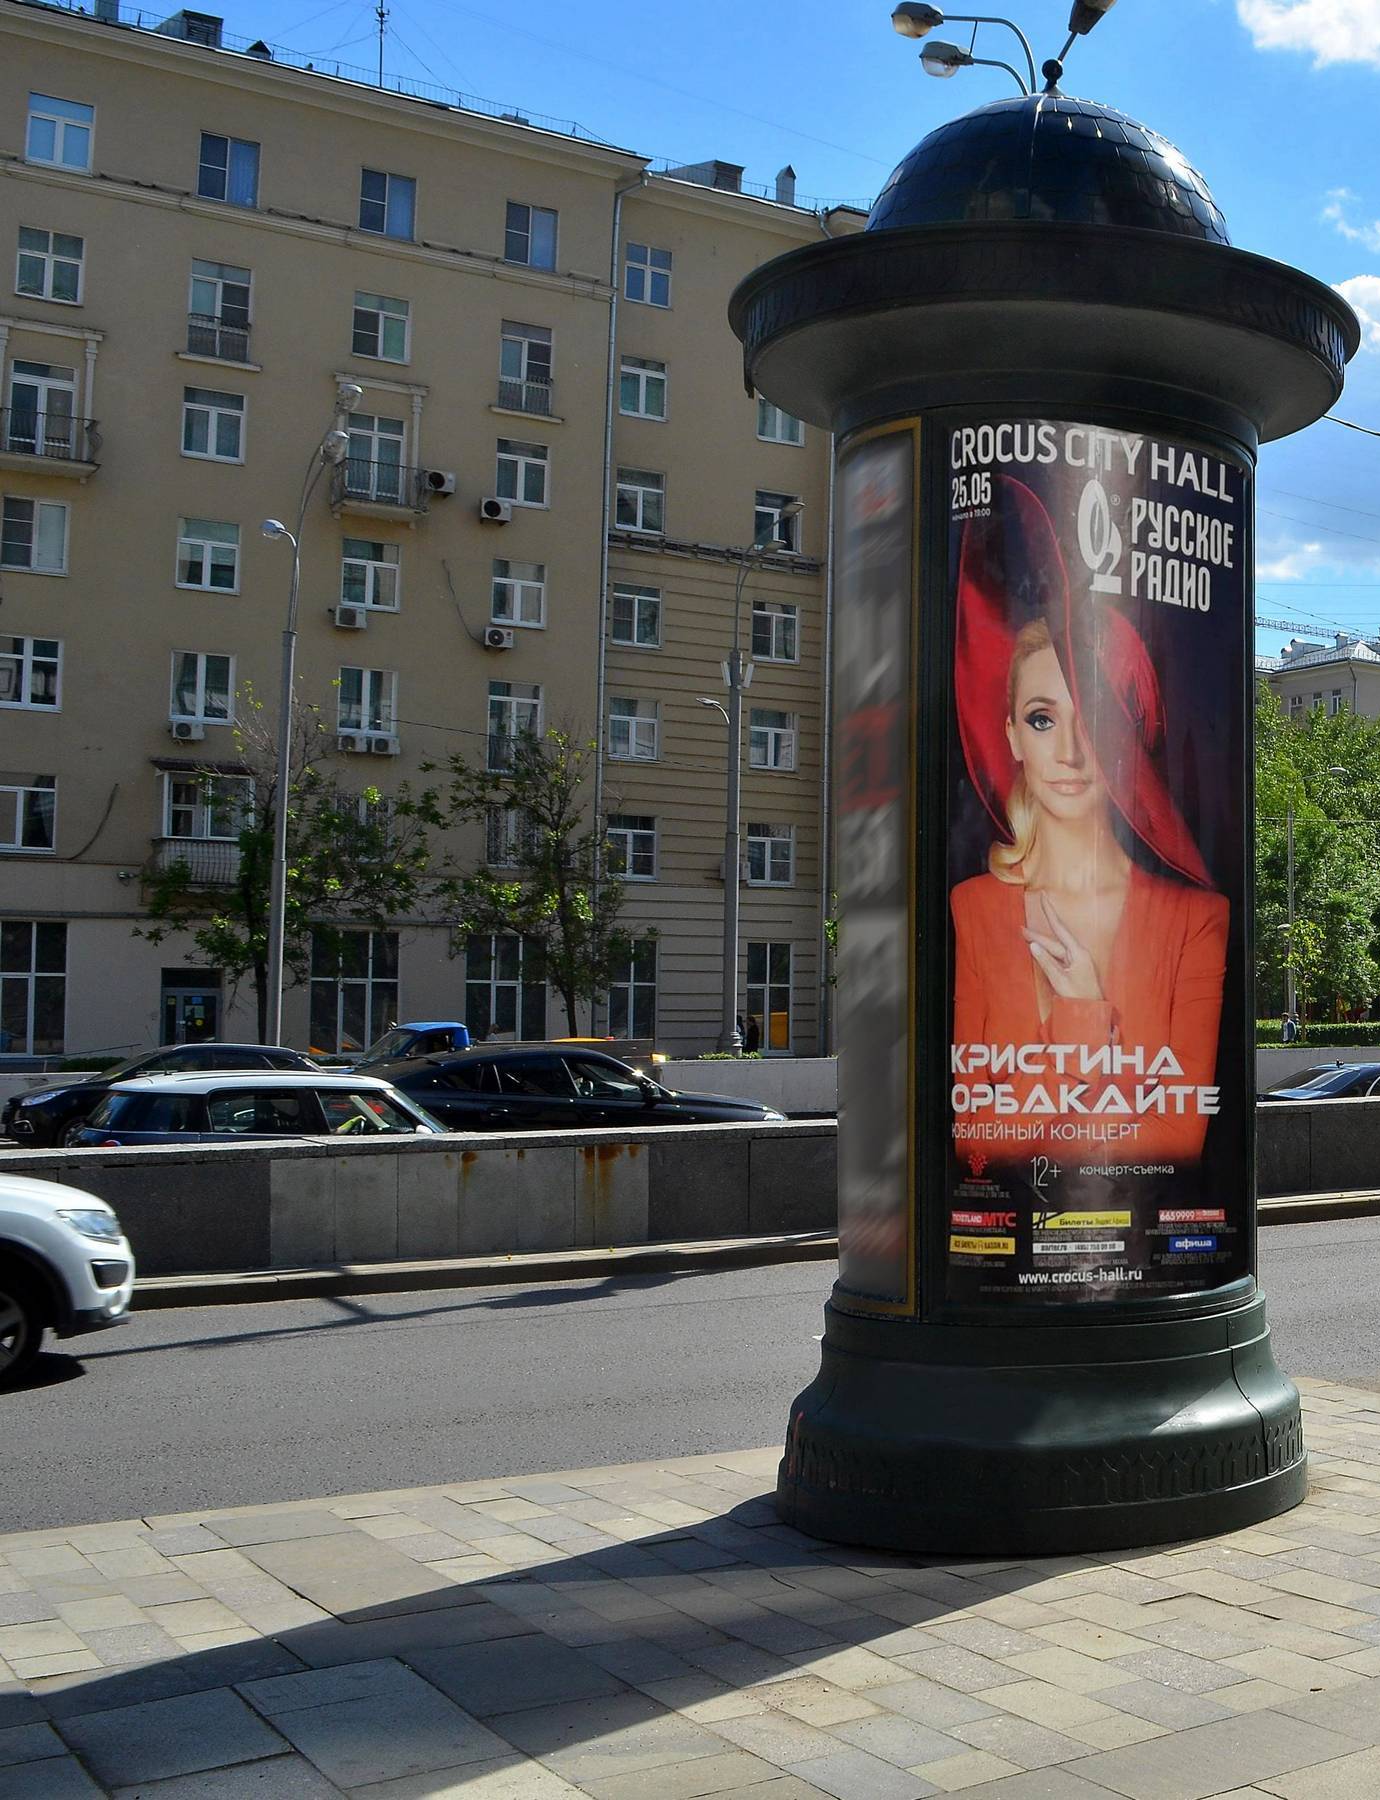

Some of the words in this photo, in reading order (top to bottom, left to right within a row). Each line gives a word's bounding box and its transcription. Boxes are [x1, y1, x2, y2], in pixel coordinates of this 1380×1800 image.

[951, 423, 1058, 470] CROCUS
[1064, 428, 1144, 475] CITY
[1151, 442, 1234, 503] HALL
[952, 471, 992, 510] 25.05
[1131, 497, 1234, 568] РУССКОЕ
[1131, 551, 1211, 613] РАДИО
[951, 1044, 1185, 1076] КРИСТИНА
[951, 1078, 1221, 1115] ОРБАКАЙТЕ
[951, 1121, 1045, 1140] ЮБИЛЕЙНЫЙ
[1051, 1123, 1142, 1142] КОНЦЕРТ
[1030, 1156, 1062, 1189] 12+
[1079, 1162, 1175, 1177] концерт-съемка
[1175, 1238, 1212, 1250] афиша
[1019, 1266, 1143, 1285] www.crocus-hall.ru
